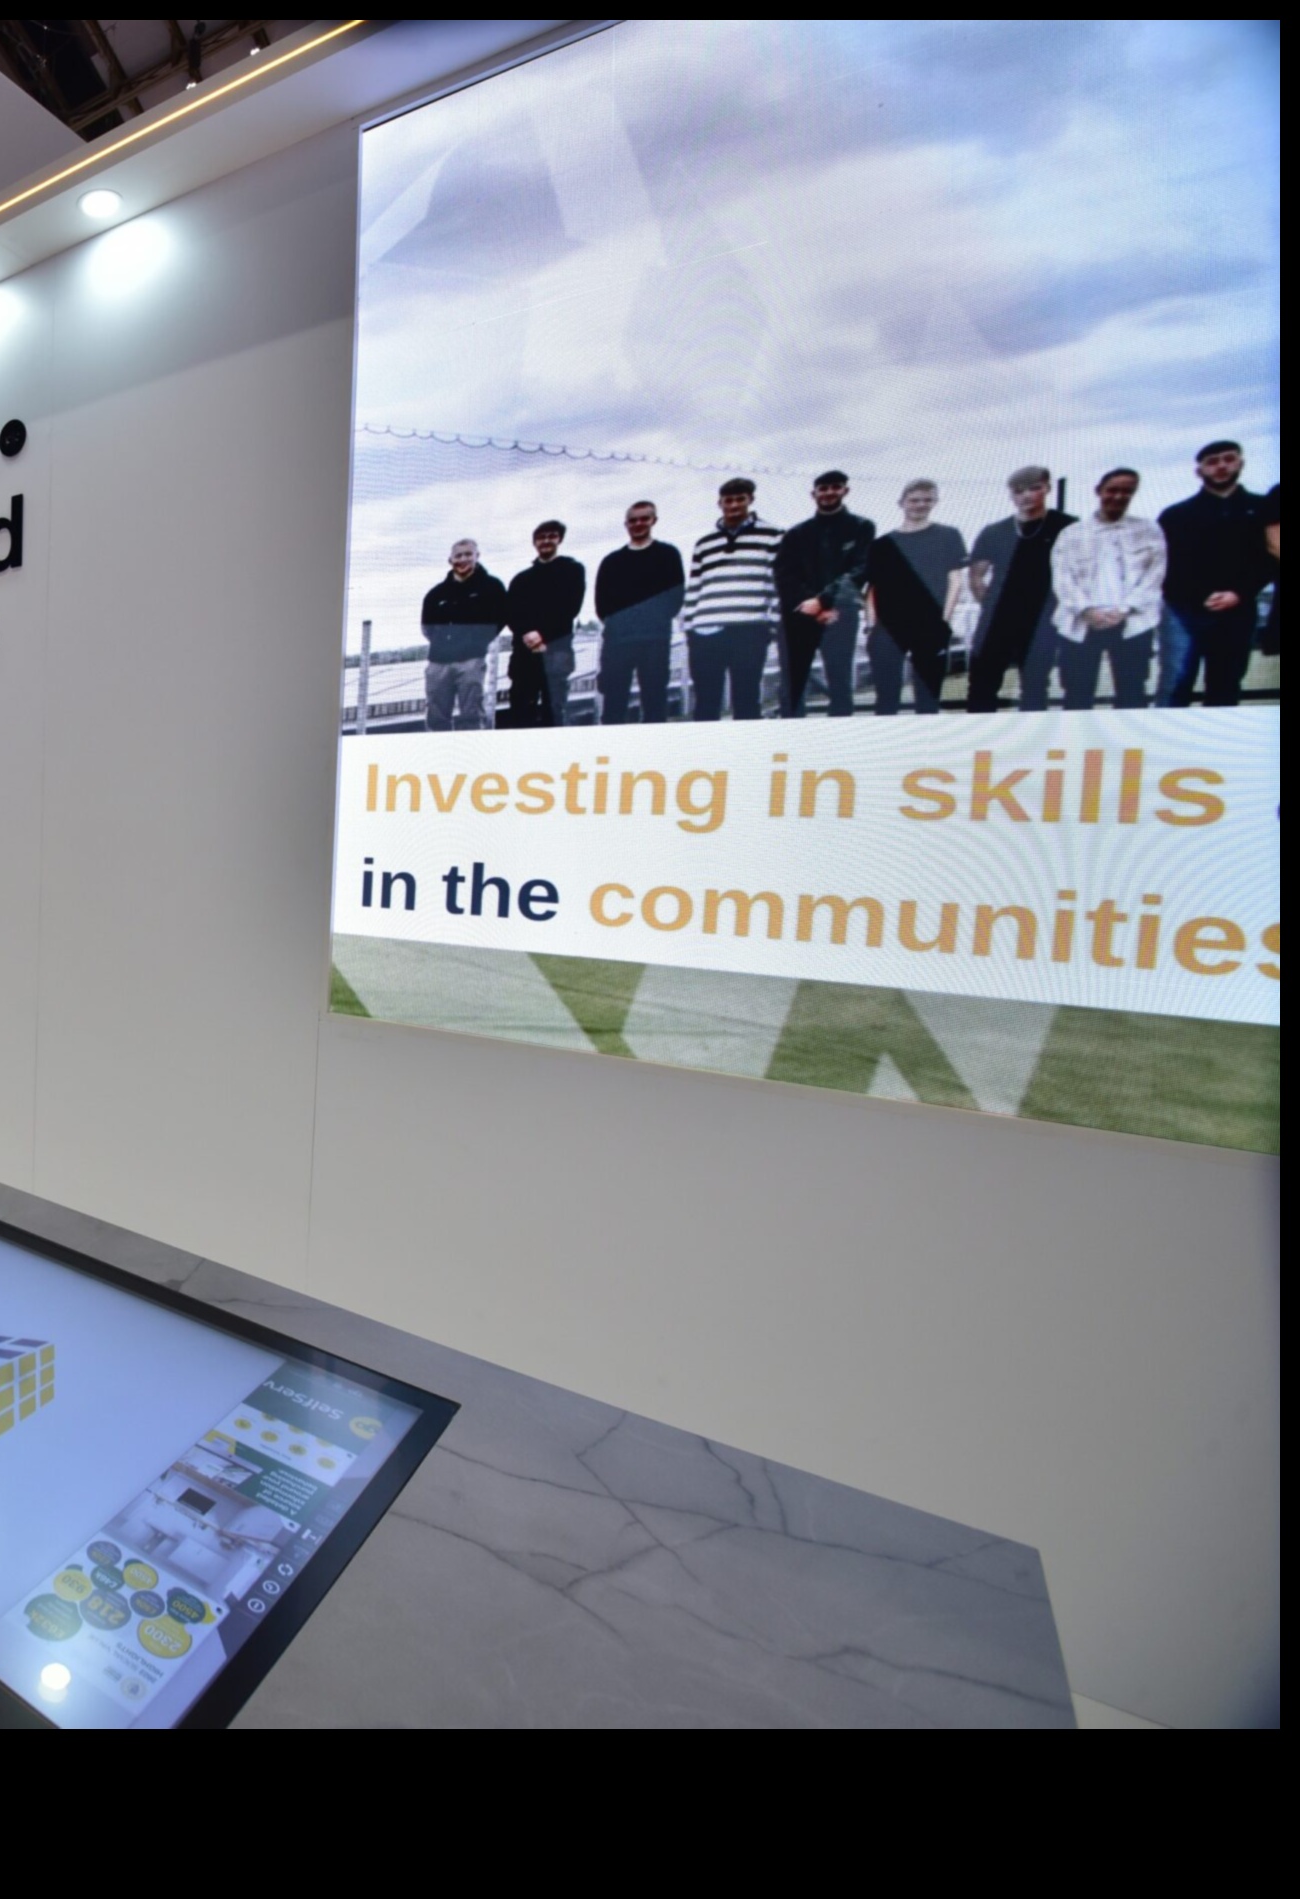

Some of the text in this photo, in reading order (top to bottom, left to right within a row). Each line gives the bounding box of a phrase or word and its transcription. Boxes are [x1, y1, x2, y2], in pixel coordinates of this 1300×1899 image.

[364, 748, 1226, 834] Investing in skills
[360, 857, 417, 911] in
[442, 861, 560, 922] the
